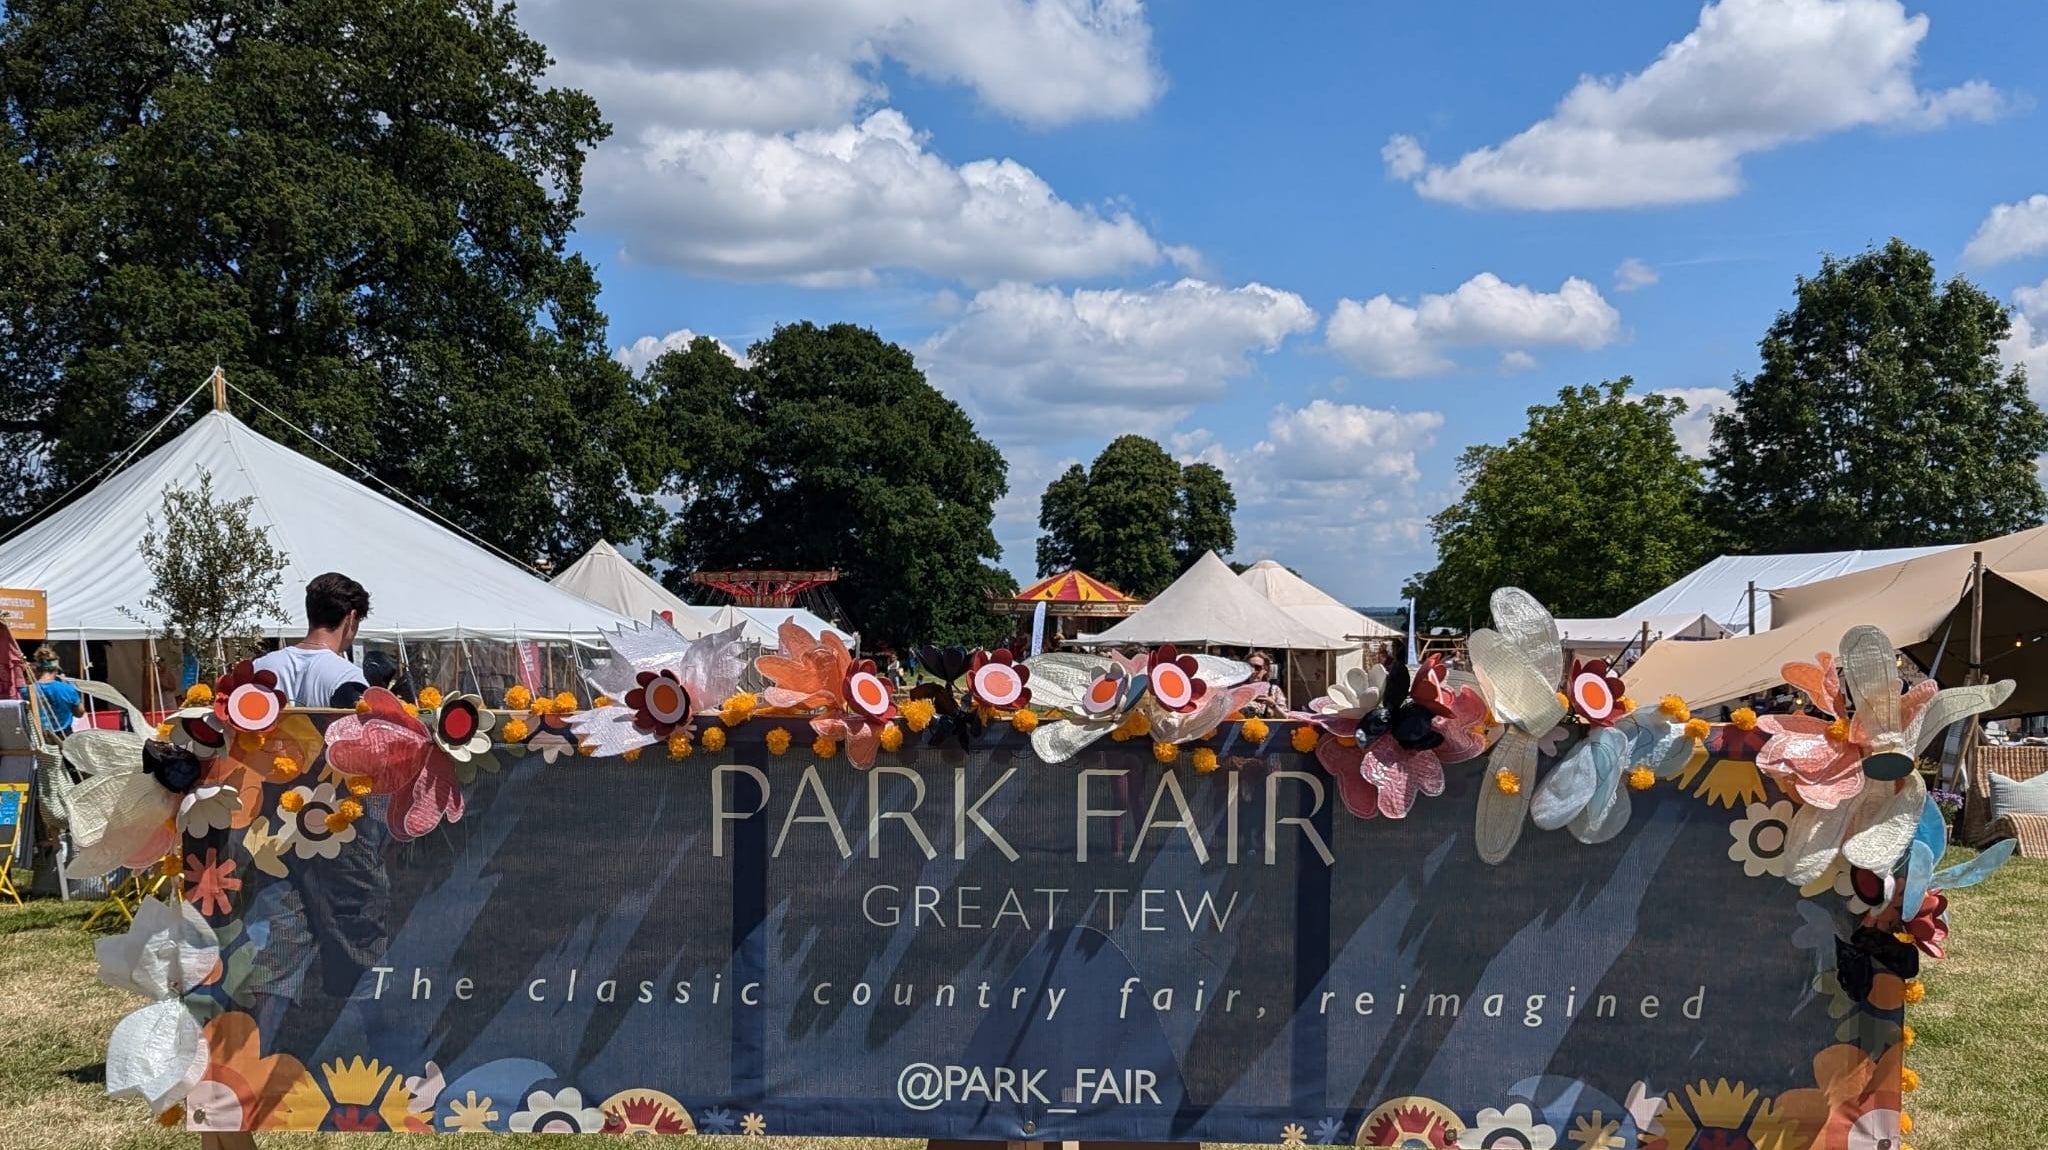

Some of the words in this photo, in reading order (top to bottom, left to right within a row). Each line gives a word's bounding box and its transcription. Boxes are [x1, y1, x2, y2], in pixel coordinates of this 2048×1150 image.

[711, 764, 1020, 863] PARK
[1076, 768, 1336, 867] FAIR
[862, 884, 1069, 931] GREAT
[1094, 888, 1239, 933] TEW
[371, 966, 474, 1001] The
[528, 968, 760, 1006] classic
[813, 980, 1066, 1021] country
[1119, 977, 1267, 1020] fair,
[1319, 984, 1705, 1028] reimagined
[897, 1062, 1162, 1114] @PARK_FAIR
